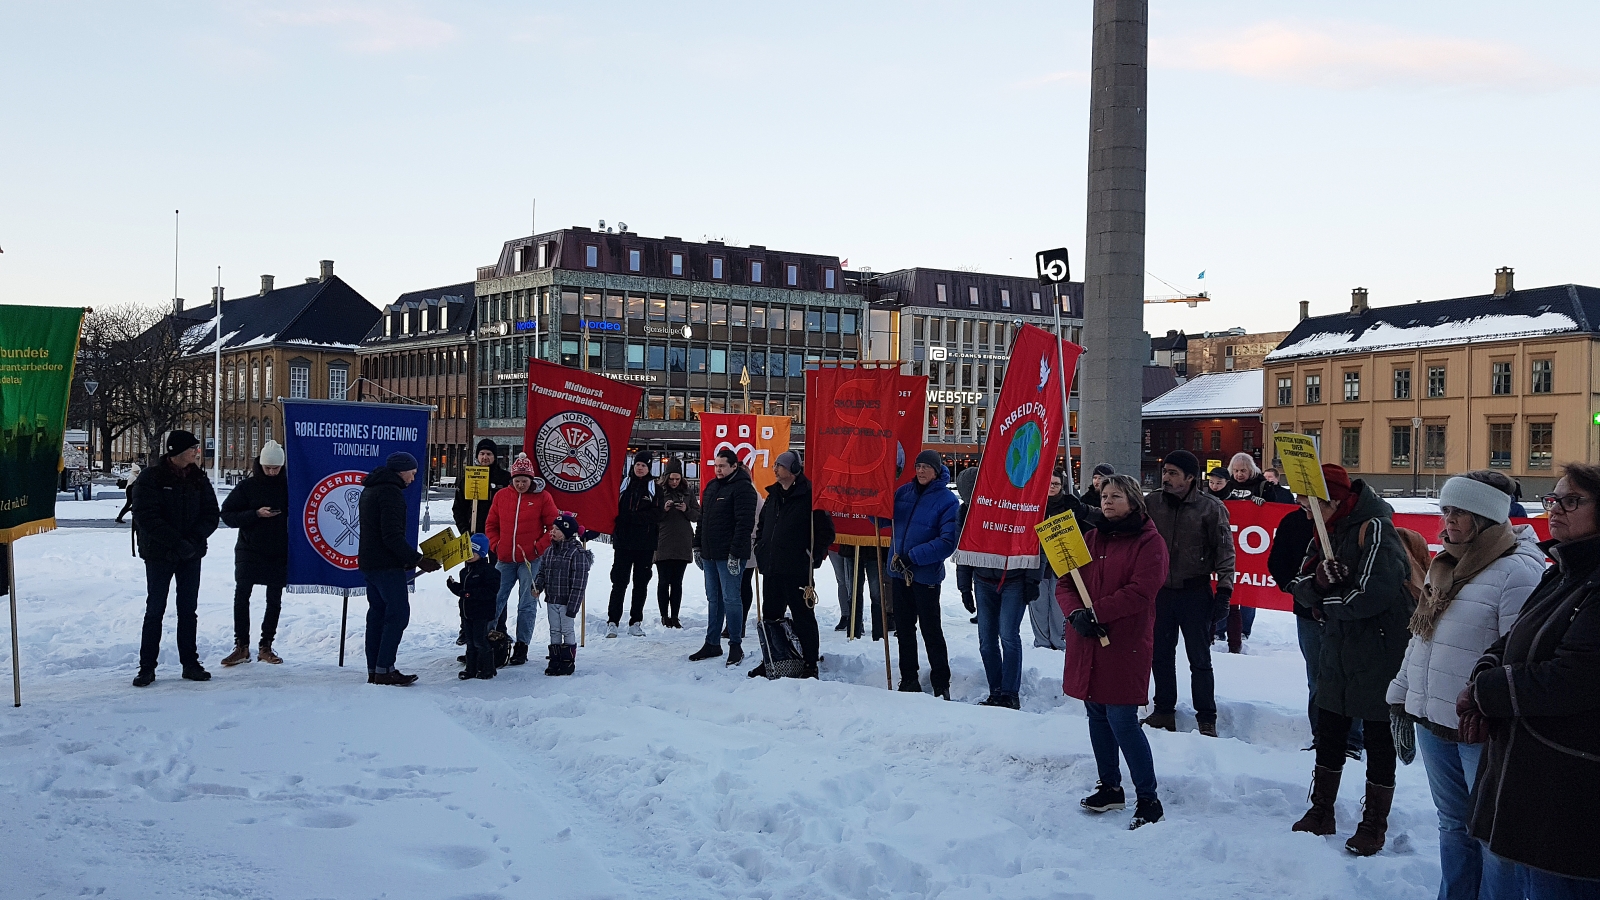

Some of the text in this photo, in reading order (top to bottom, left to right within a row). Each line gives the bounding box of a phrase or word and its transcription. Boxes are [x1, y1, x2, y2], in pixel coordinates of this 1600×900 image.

[1038, 254, 1067, 281] LO
[516, 320, 537, 330] Norde
[580, 320, 621, 331] Nordea
[564, 380, 604, 398] Midtnorsk
[531, 382, 632, 417] Transportarbeiderforening
[833, 399, 881, 409] SKOLENES
[926, 390, 983, 405] WEBSTEP
[562, 413, 595, 428] NORSK
[999, 402, 1033, 437] ARBEID
[1033, 401, 1046, 422] FOR
[294, 421, 418, 442] RØRLEGGERNES FORENING
[333, 442, 380, 457] TRONDHEIM
[826, 485, 879, 498] TRONDHEIM
